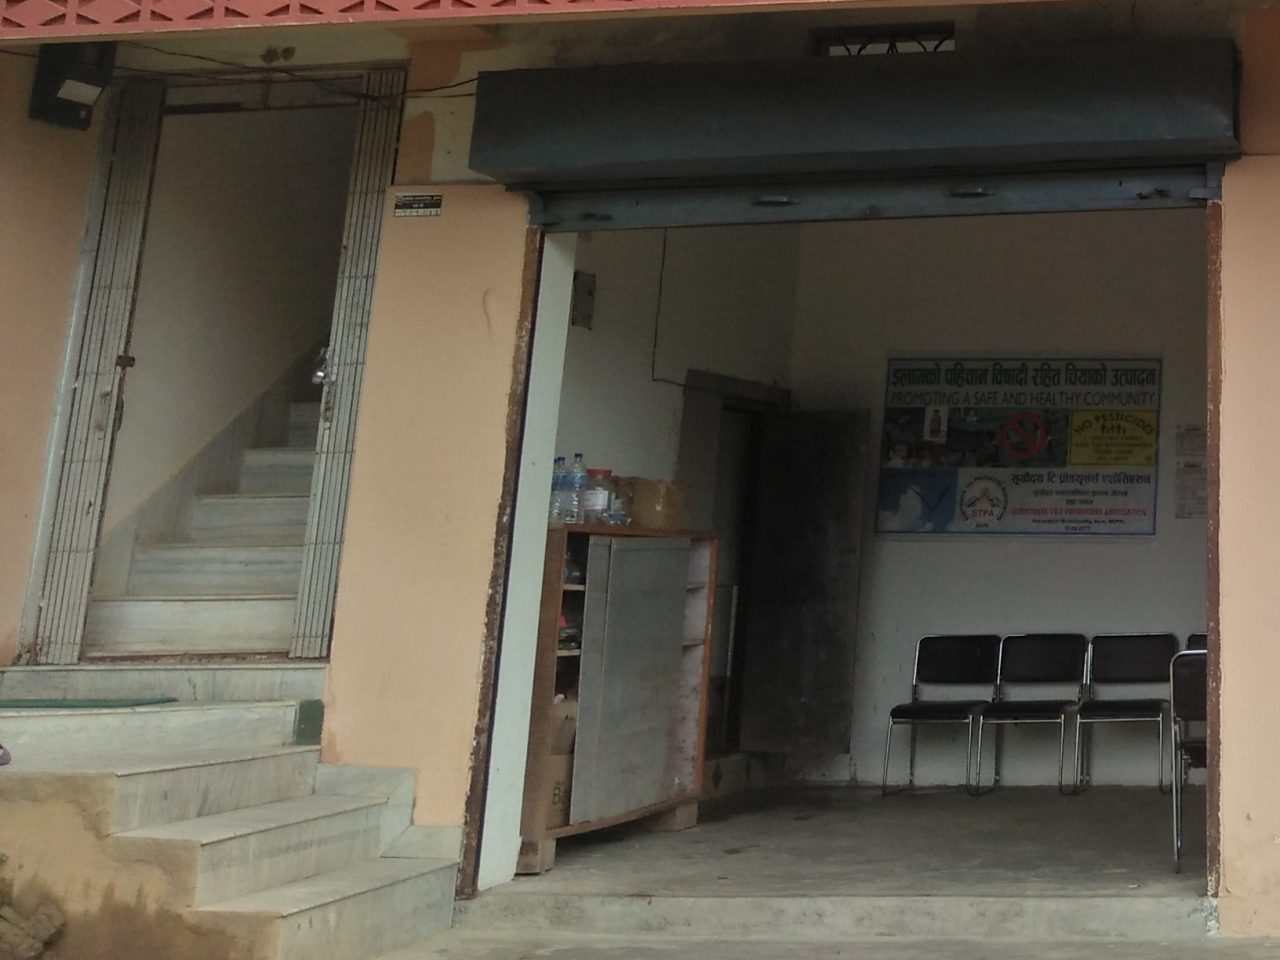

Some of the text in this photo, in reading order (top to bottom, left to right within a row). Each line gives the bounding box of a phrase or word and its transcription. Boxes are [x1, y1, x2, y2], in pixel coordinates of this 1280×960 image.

[891, 392, 1155, 405] PROMOTING A SAFE AND HEALTHY COMMUNITY
[1074, 412, 1154, 435] NO PESTICIDES
[971, 508, 994, 517] STPA
